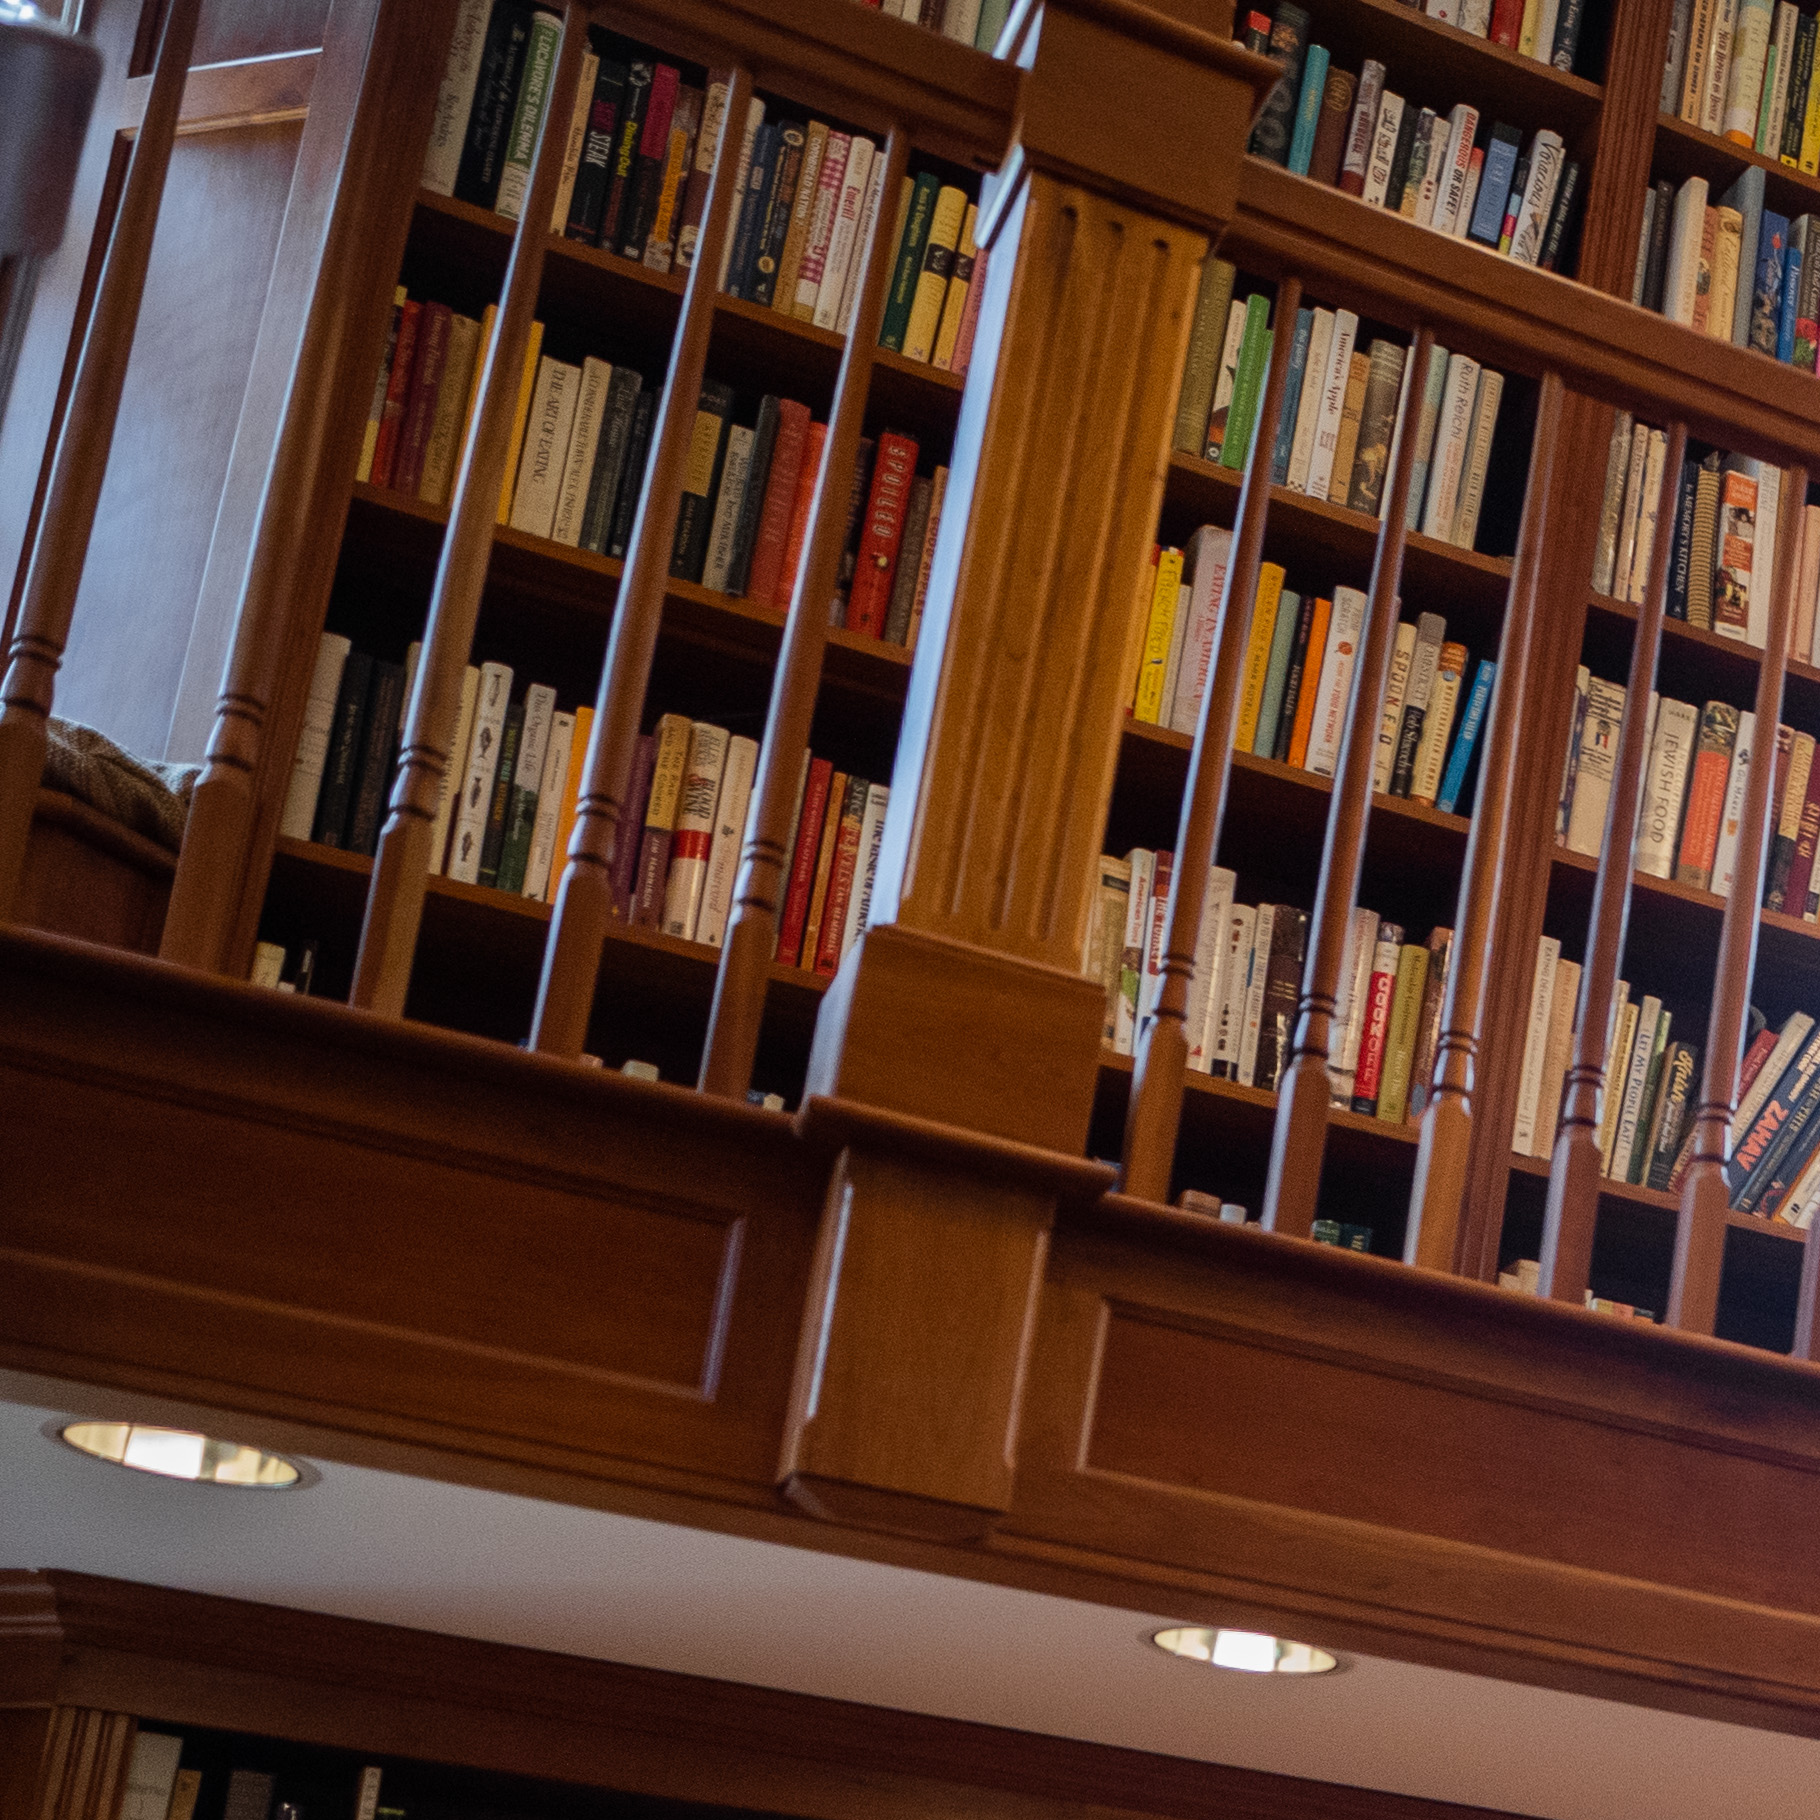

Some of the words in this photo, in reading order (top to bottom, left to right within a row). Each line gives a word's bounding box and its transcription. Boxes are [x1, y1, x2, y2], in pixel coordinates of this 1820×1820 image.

[585, 130, 612, 168] STEAK
[619, 120, 639, 154] Dining
[616, 155, 632, 178] Out
[1456, 363, 1474, 394] Ruth
[1677, 493, 1694, 545] MEMORY'S
[1206, 563, 1228, 614] EATING
[1674, 547, 1690, 593] KITCHEN
[1192, 634, 1215, 701] AMERICA
[1655, 732, 1680, 793] JEWISH
[1649, 795, 1673, 844] FOOD
[1670, 1049, 1695, 1103] Knish
[1735, 1099, 1789, 1171] ZAHAV
